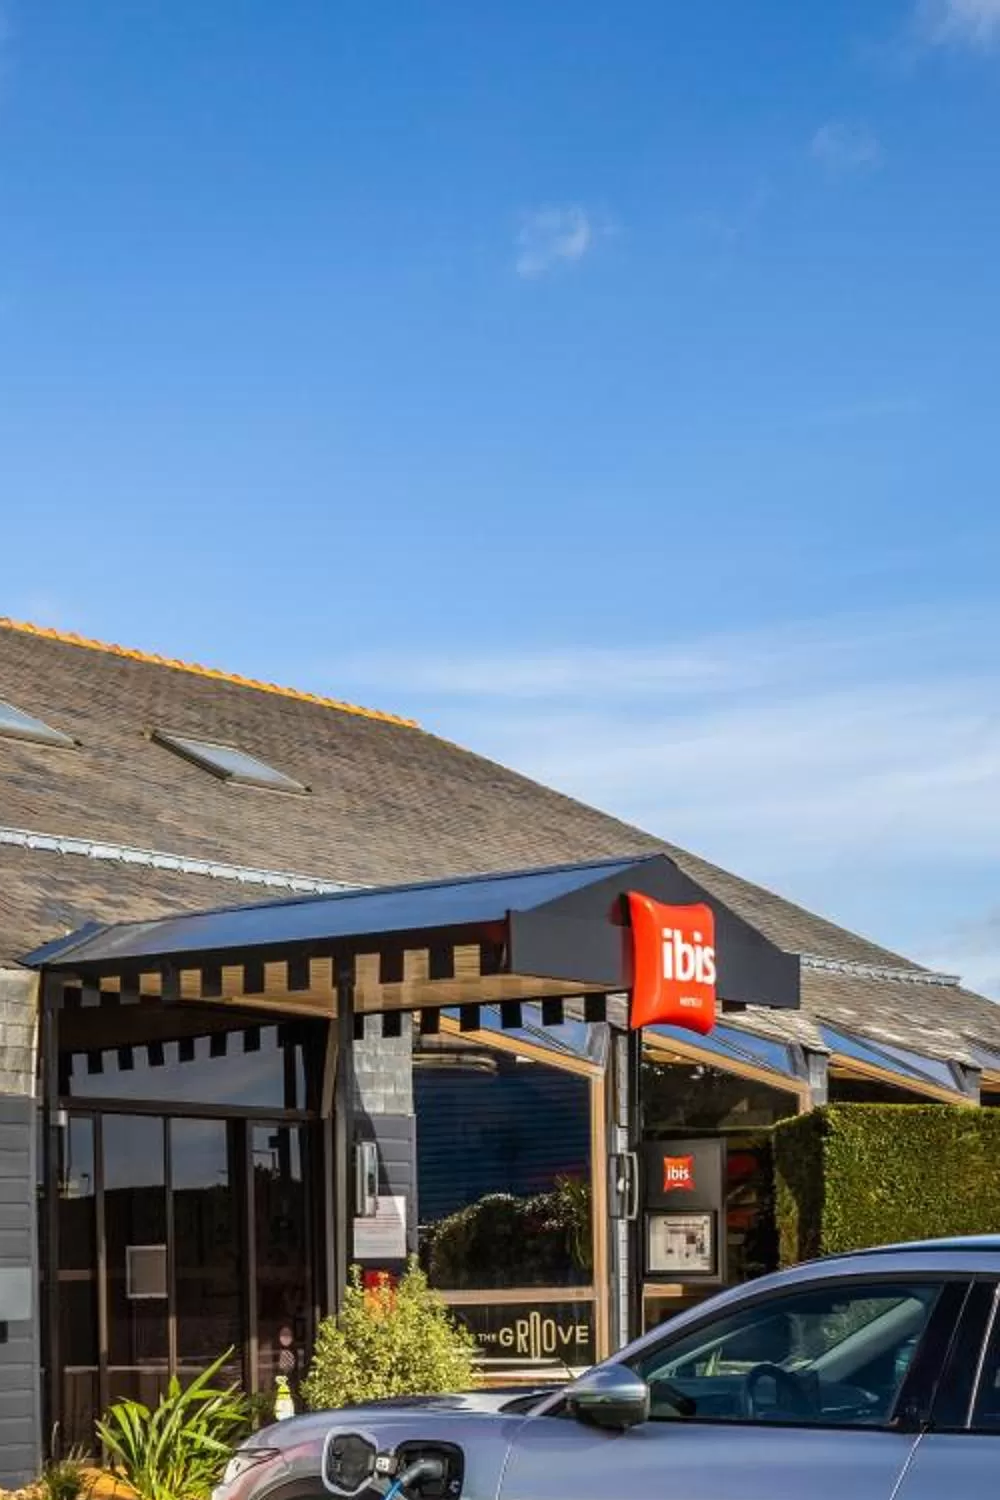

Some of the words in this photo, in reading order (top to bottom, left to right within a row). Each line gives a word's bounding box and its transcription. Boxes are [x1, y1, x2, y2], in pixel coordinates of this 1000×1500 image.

[662, 927, 716, 985] ibis
[667, 1165, 690, 1181] ibis
[499, 1311, 589, 1360] GROOVE
